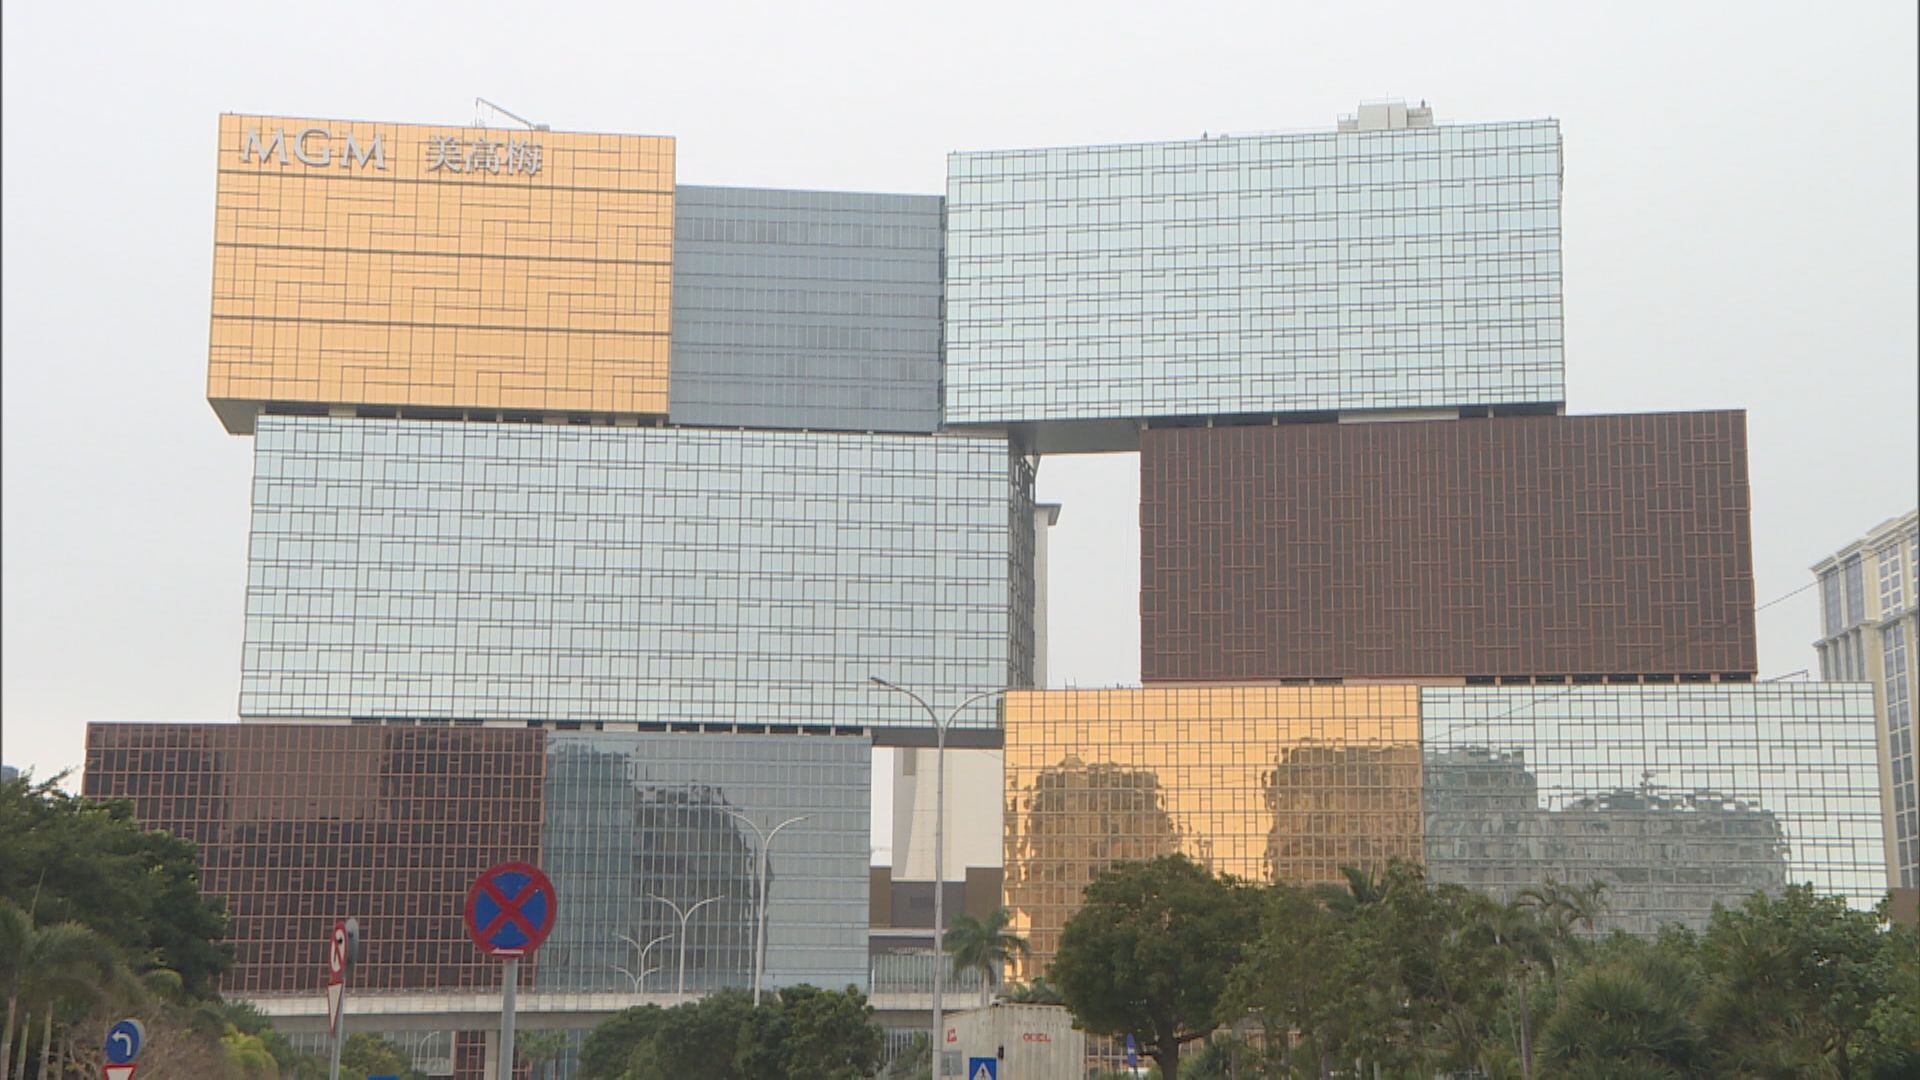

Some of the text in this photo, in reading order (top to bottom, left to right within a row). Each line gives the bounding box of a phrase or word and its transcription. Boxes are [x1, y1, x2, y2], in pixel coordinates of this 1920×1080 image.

[241, 127, 388, 170] MGM
[427, 135, 542, 176] 美高梅
